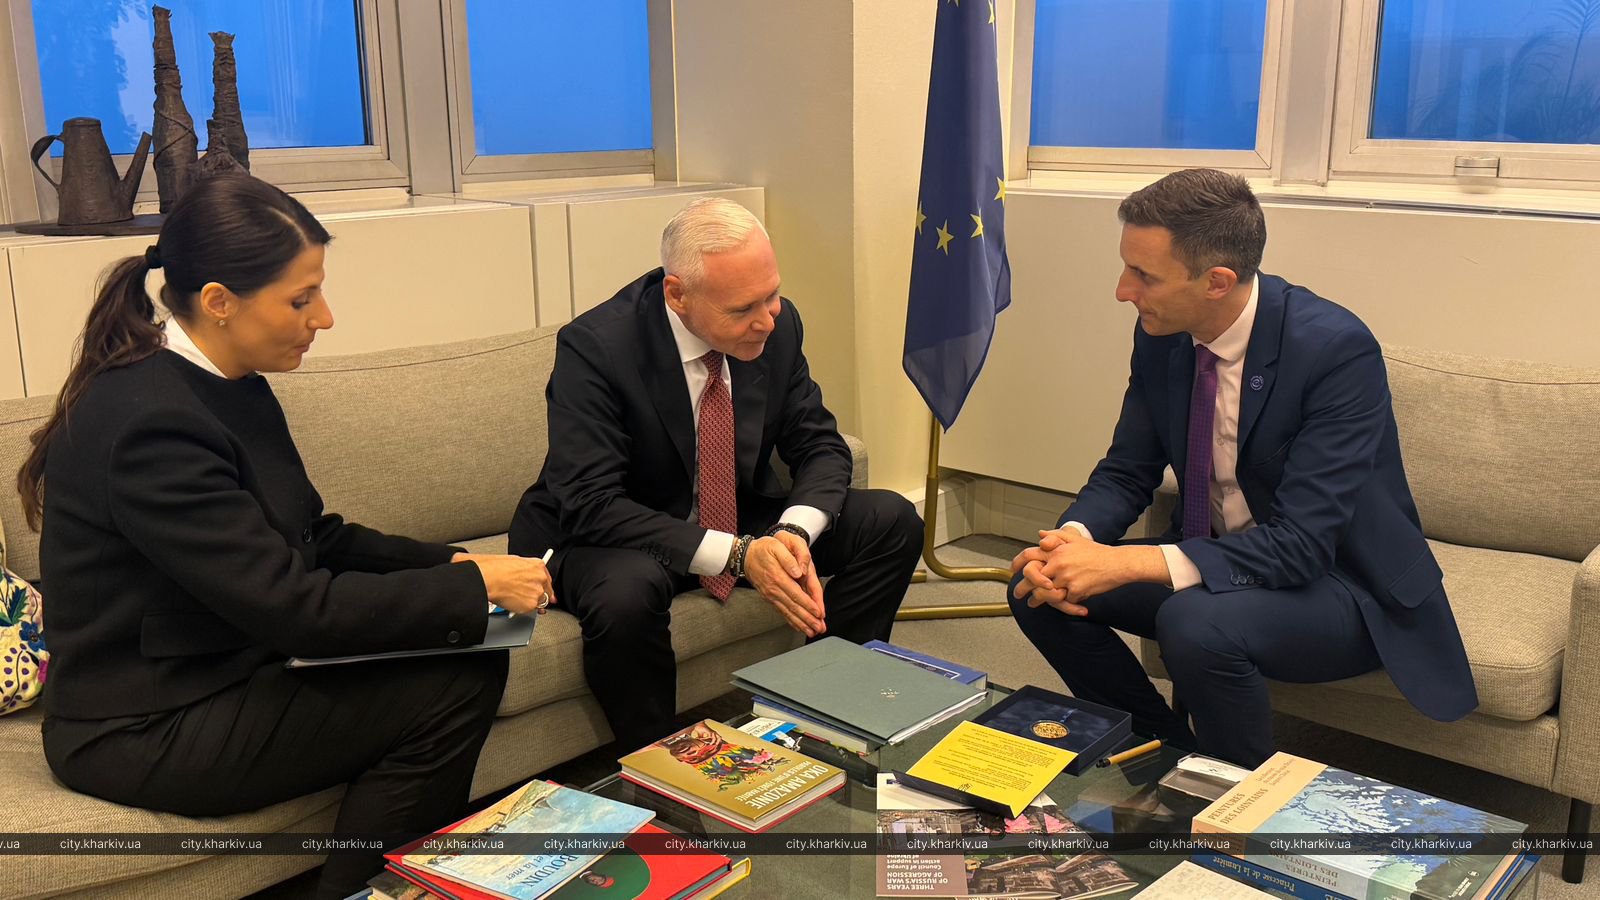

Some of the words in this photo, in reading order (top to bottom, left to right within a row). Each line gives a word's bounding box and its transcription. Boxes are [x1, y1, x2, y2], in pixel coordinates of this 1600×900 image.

[800, 764, 829, 781] OKA
[744, 774, 807, 810] AMAZONIE
[1208, 793, 1246, 821] PEINTURES
[1220, 811, 1234, 825] DES
[1234, 787, 1269, 815] LOINTAINS
[522, 860, 535, 869] la
[534, 855, 545, 864] et
[1212, 856, 1241, 874] Lumière
[1268, 850, 1318, 872] LOINTAINS
[505, 865, 525, 881] mer
[520, 853, 579, 888] BOUDIN
[1242, 866, 1251, 876] la
[1251, 869, 1261, 880] de
[1285, 864, 1338, 887] PEINTURES
[1318, 865, 1338, 878] DES
[1262, 873, 1296, 892] Princesse
